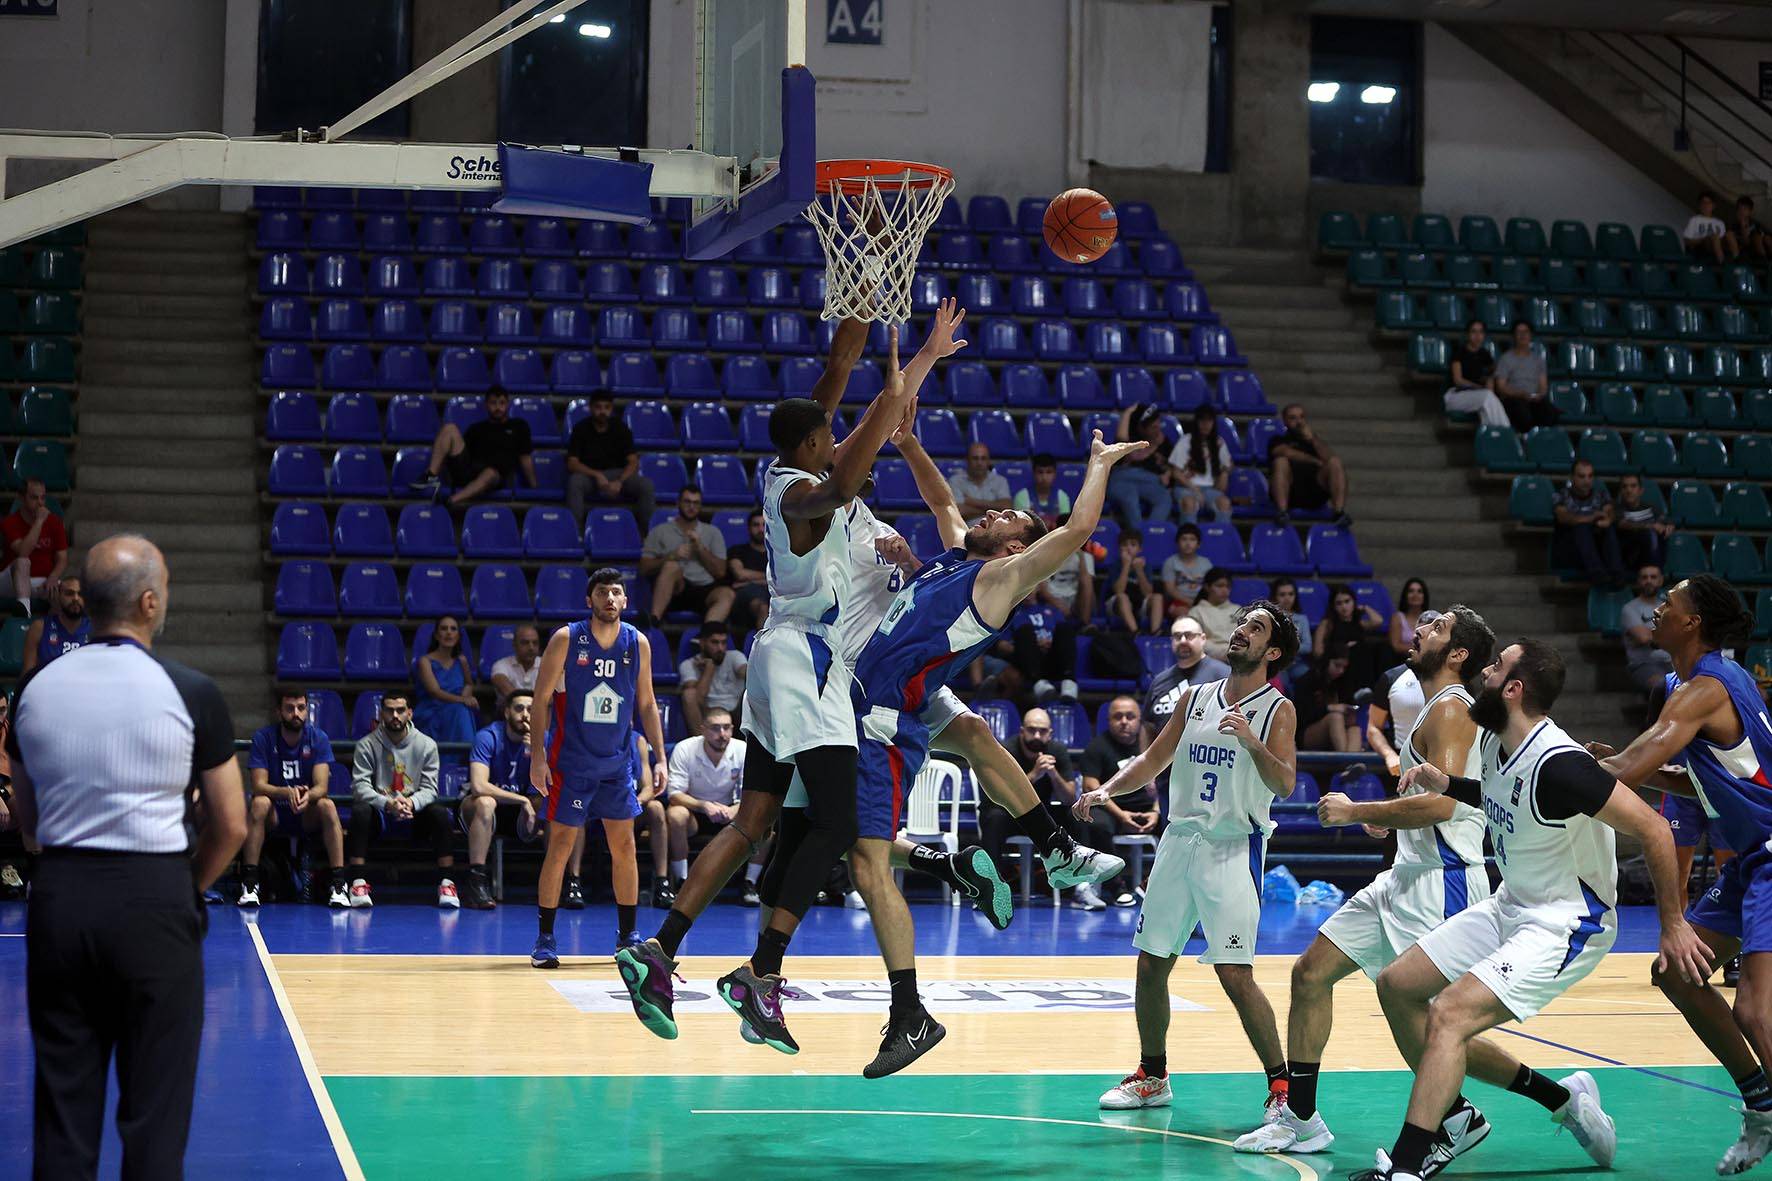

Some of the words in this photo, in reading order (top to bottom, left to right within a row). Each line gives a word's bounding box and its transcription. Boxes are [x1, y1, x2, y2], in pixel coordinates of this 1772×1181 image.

[829, 0, 880, 36] A4
[593, 659, 616, 678] 30
[592, 696, 612, 714] YB
[1189, 743, 1236, 769] HOOPS
[282, 760, 300, 780] 51
[508, 761, 517, 779] 7
[1200, 772, 1218, 803] 3
[1136, 913, 1145, 934] 3
